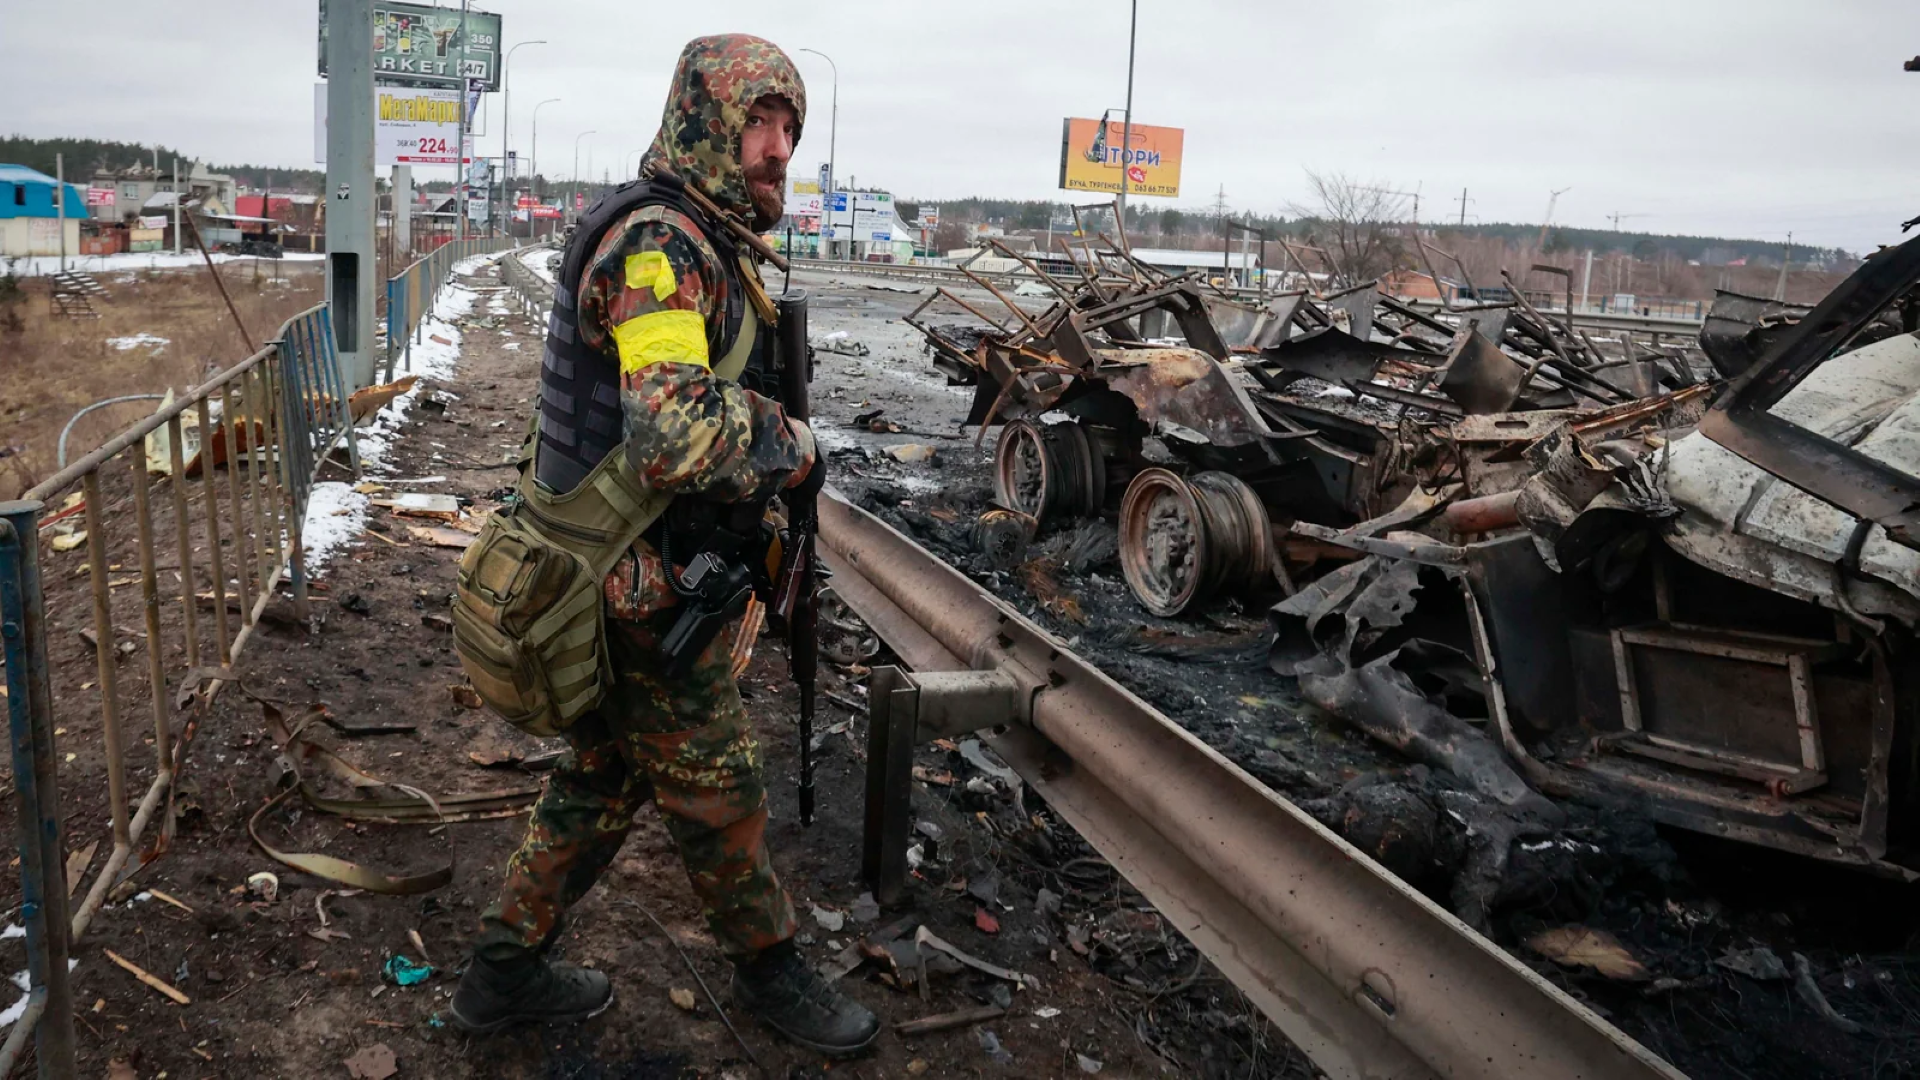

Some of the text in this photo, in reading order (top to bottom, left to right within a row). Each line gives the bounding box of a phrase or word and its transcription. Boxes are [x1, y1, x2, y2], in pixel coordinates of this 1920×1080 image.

[470, 33, 493, 45] 350
[374, 56, 448, 75] RKET
[1134, 185, 1147, 193] 063
[809, 199, 819, 209] 42
